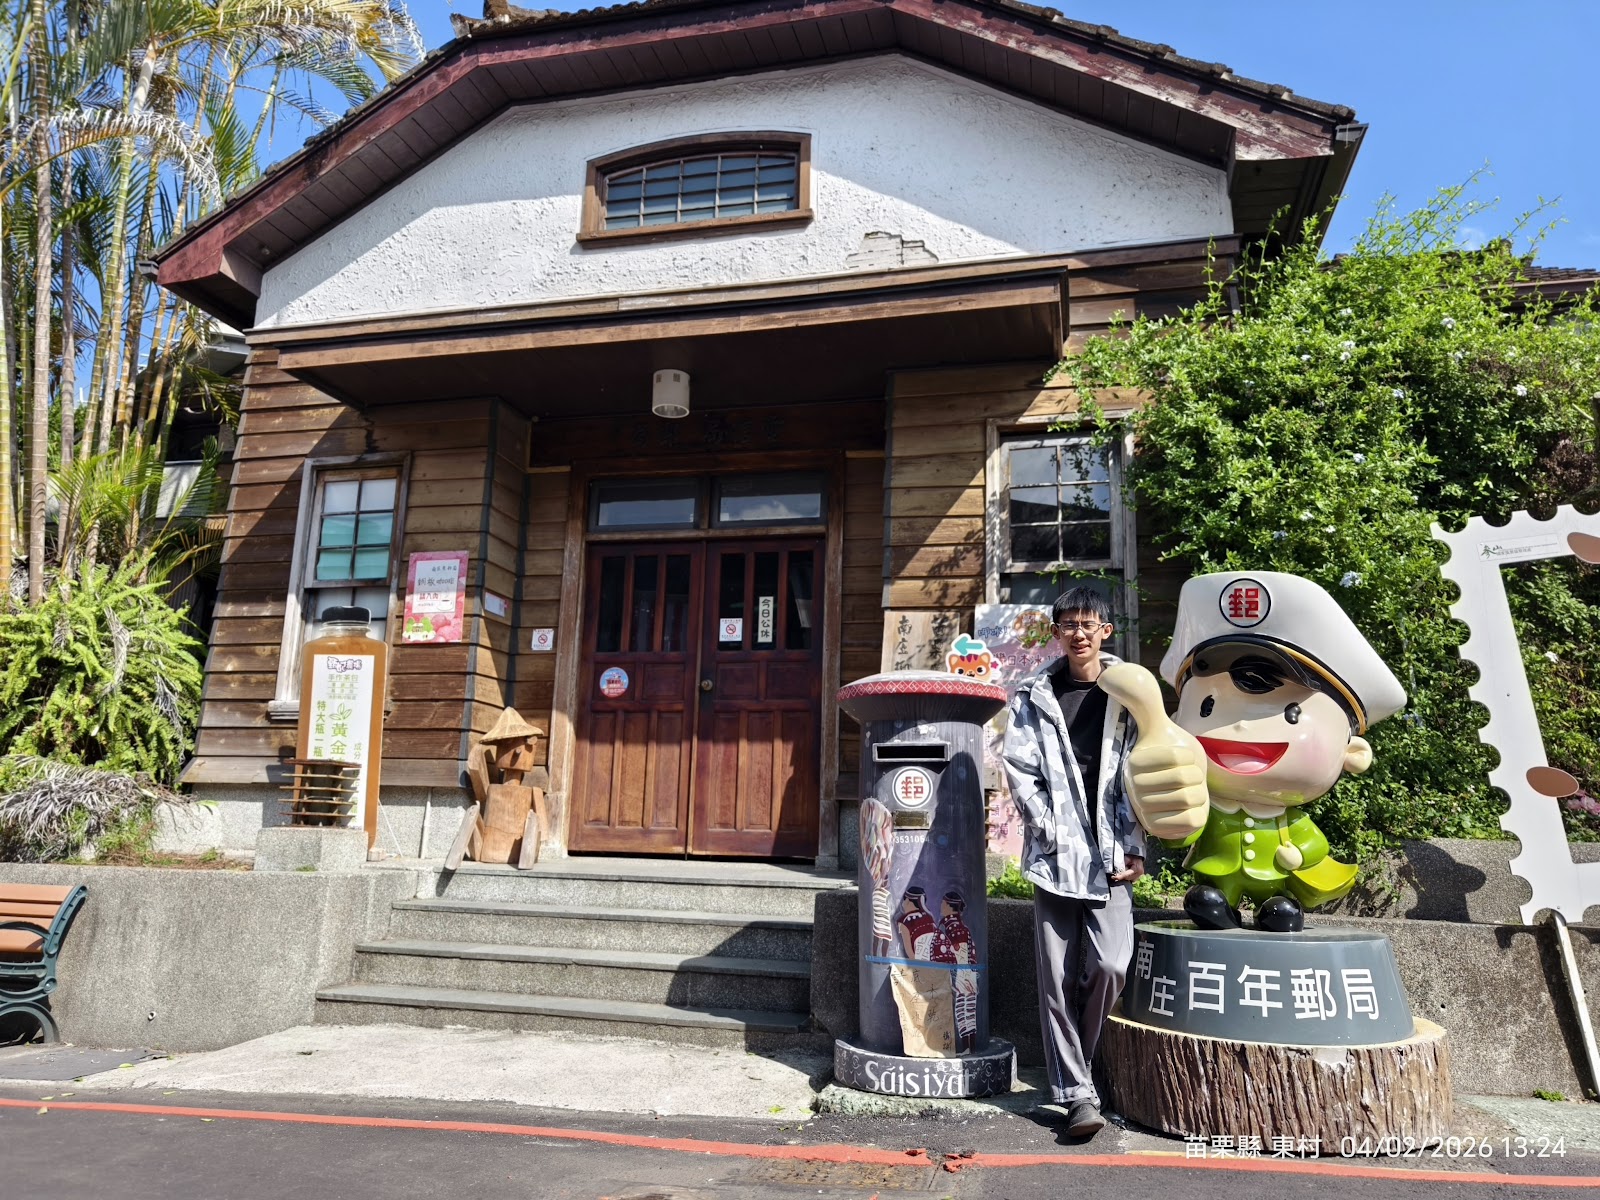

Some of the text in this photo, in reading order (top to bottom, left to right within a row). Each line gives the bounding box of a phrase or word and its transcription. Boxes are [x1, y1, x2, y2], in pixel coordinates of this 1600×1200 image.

[761, 598, 771, 639] 今日公休
[313, 700, 326, 758] 特大瓶一瓶
[329, 722, 348, 762] 黃金
[1187, 961, 1380, 1021] 百年郵局
